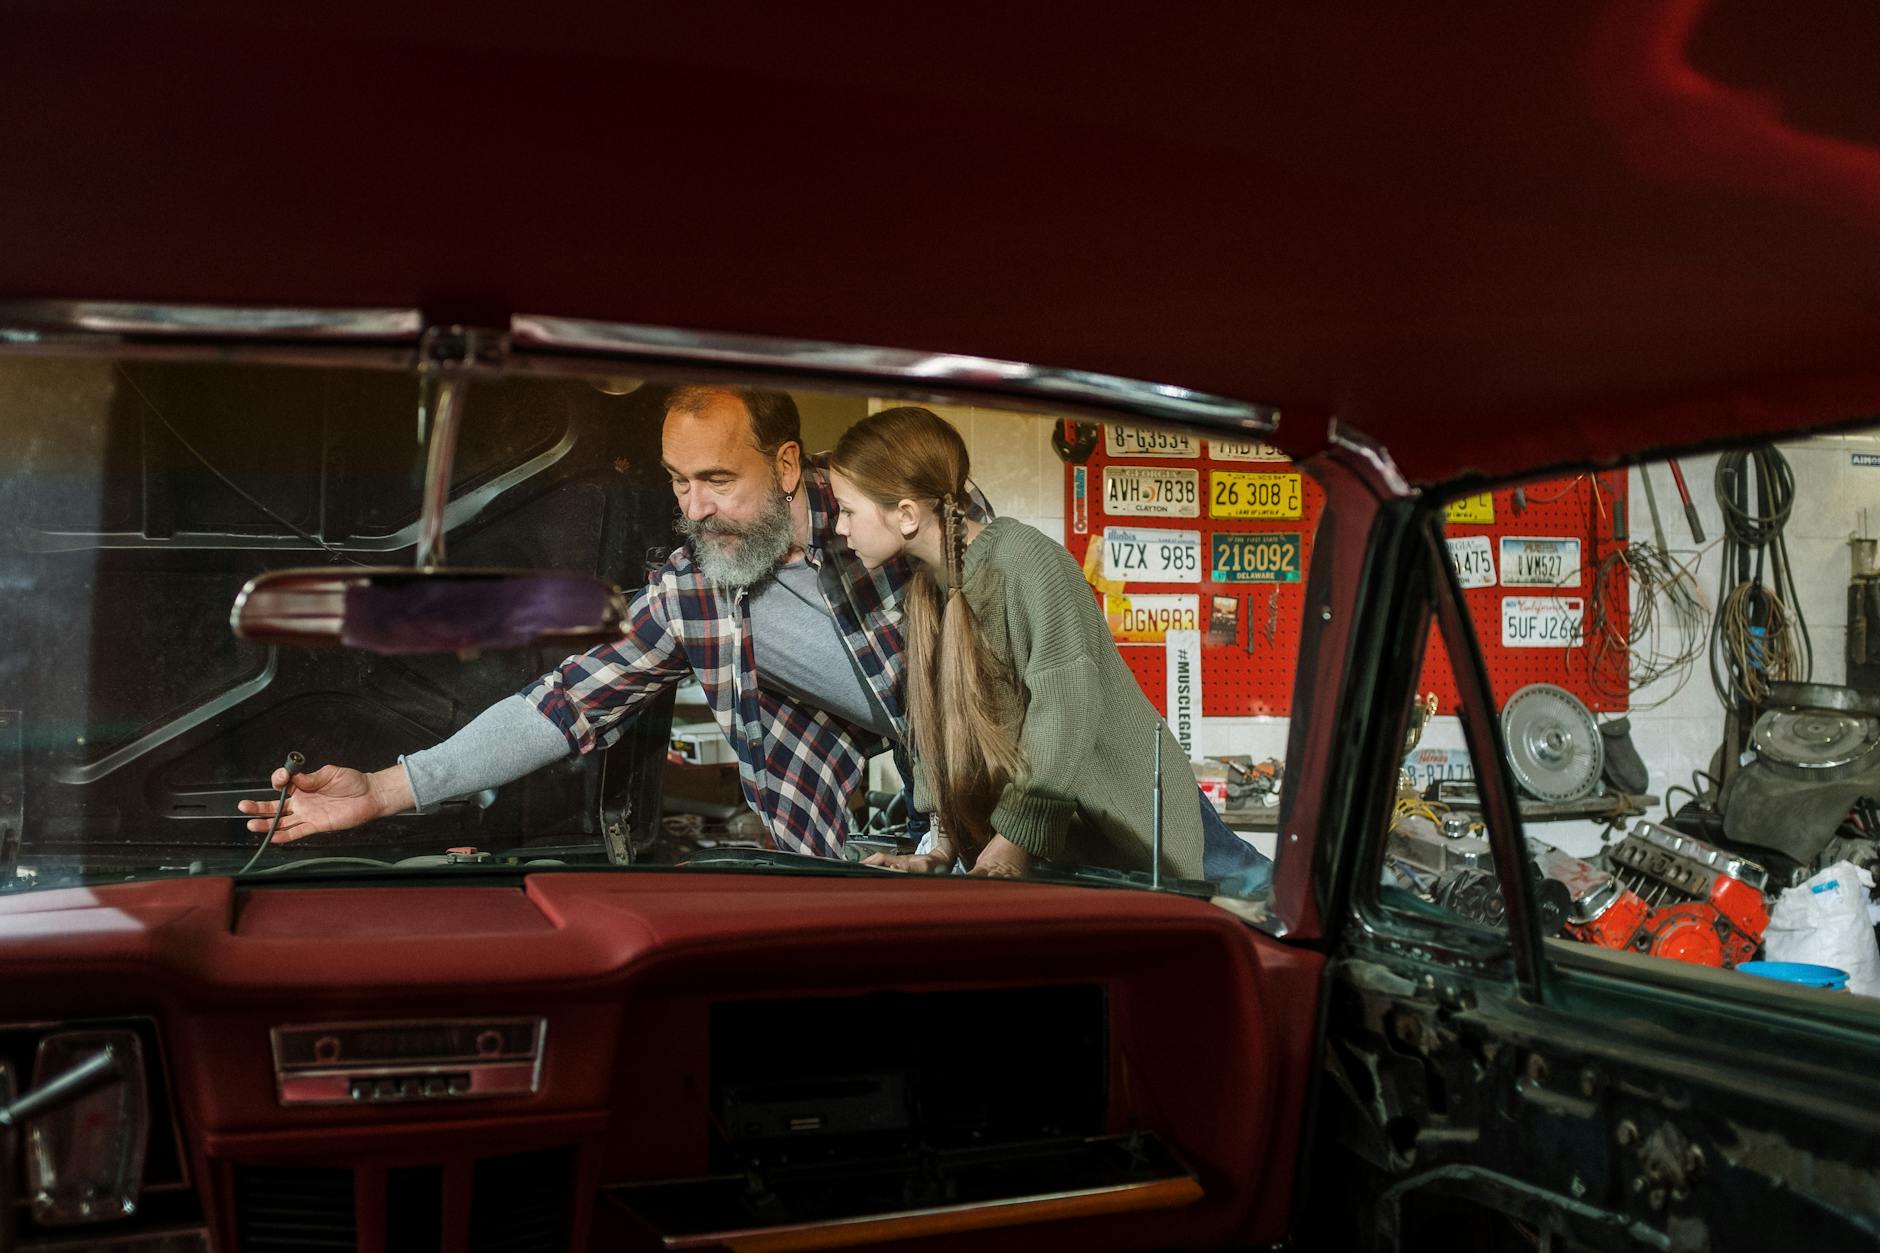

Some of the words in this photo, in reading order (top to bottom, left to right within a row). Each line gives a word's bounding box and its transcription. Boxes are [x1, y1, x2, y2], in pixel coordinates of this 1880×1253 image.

[1109, 476, 1140, 502] AVH
[1154, 479, 1196, 503] 7838
[1216, 481, 1239, 505] 26
[1247, 483, 1281, 506] 308
[1136, 505, 1168, 513] CLAYTON
[1111, 542, 1148, 570] VZX
[1160, 545, 1196, 571] 985
[1217, 543, 1295, 572] 216092
[1236, 571, 1275, 580] DELAWARE
[1177, 648, 1192, 761] #MUSCLEGAR
